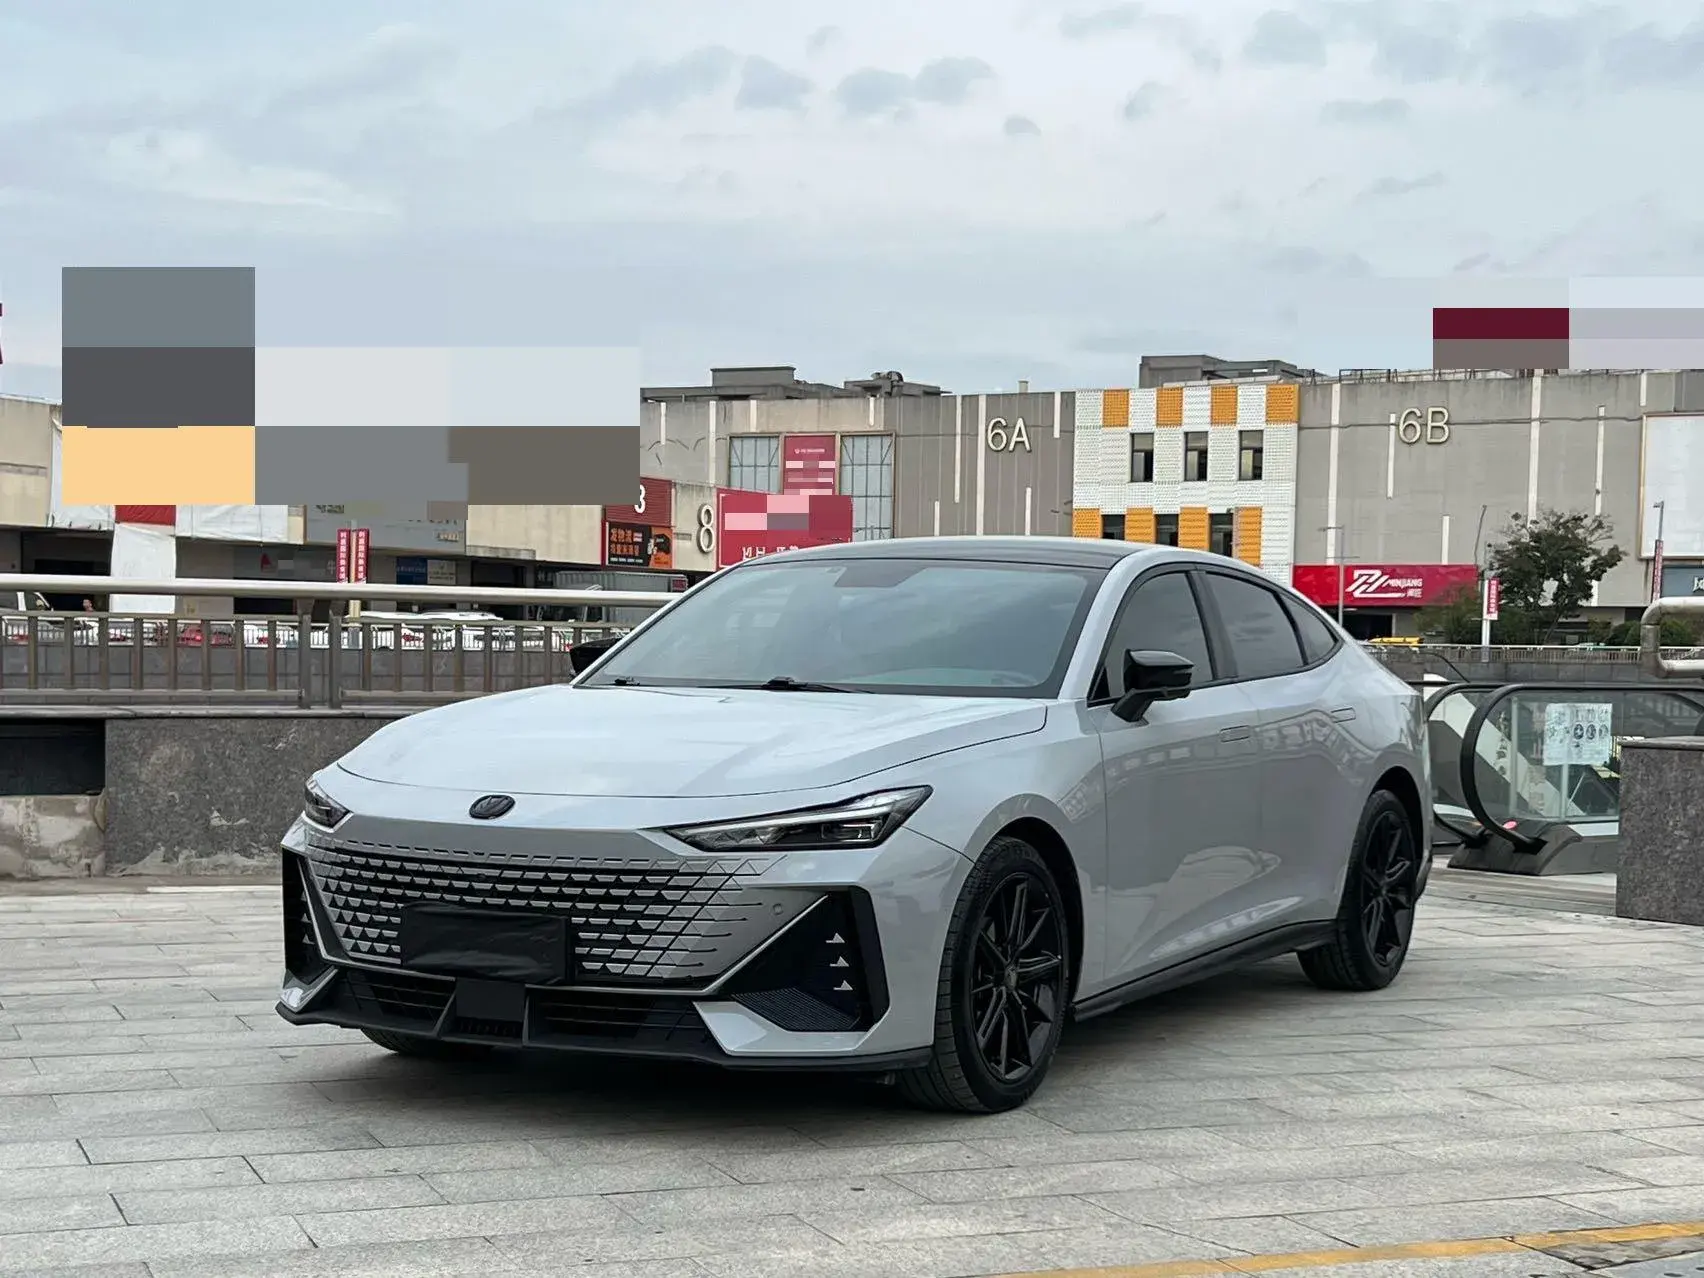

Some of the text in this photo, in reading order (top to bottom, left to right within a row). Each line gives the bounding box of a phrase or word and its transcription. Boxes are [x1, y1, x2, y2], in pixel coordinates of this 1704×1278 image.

[987, 417, 1032, 452] 6A
[1399, 406, 1449, 445] 6B
[697, 503, 715, 554] 8
